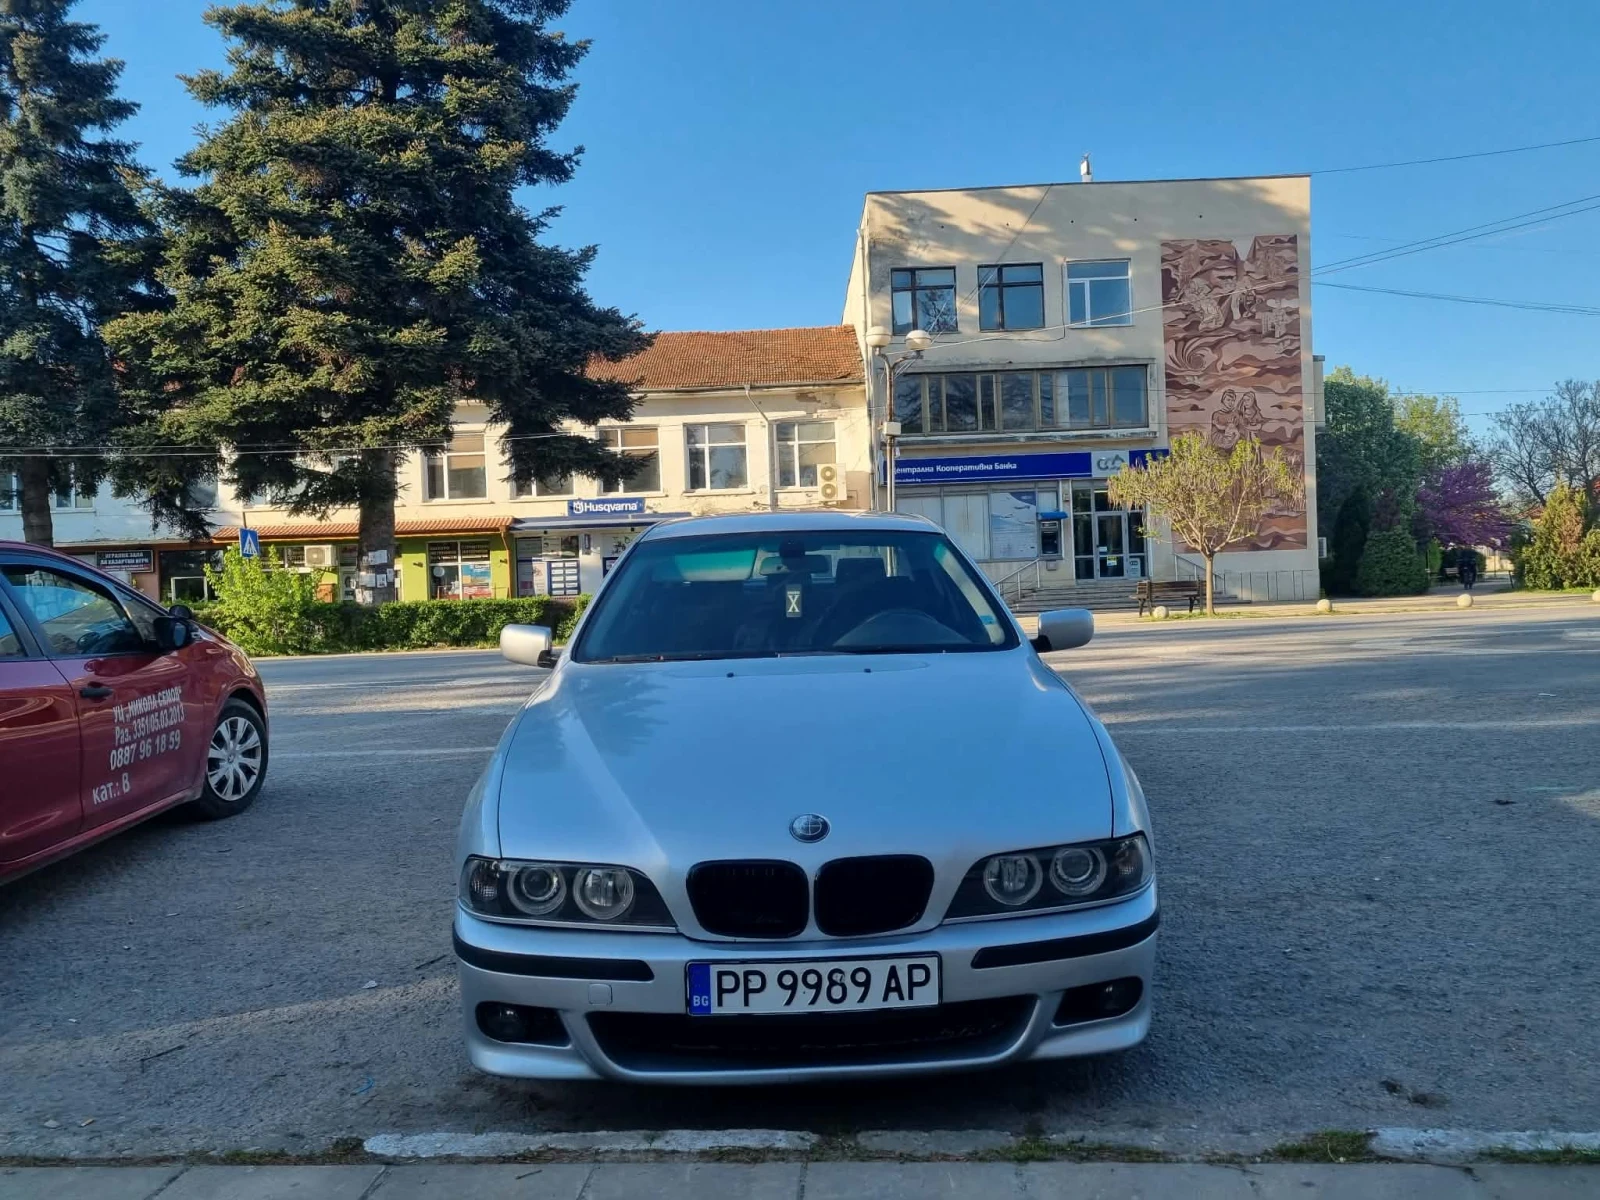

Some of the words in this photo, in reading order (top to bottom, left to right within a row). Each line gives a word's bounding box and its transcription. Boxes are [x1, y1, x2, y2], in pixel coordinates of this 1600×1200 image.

[936, 461, 993, 474] Кооперативна
[994, 462, 1017, 470] Банка
[584, 502, 638, 513] Husqvarna
[115, 726, 132, 747] Раз.
[110, 742, 137, 770] 0887
[139, 738, 152, 760] 96
[155, 733, 167, 755] 18
[168, 729, 181, 750] 59
[776, 966, 872, 1007] 9989
[693, 995, 709, 1007] BG
